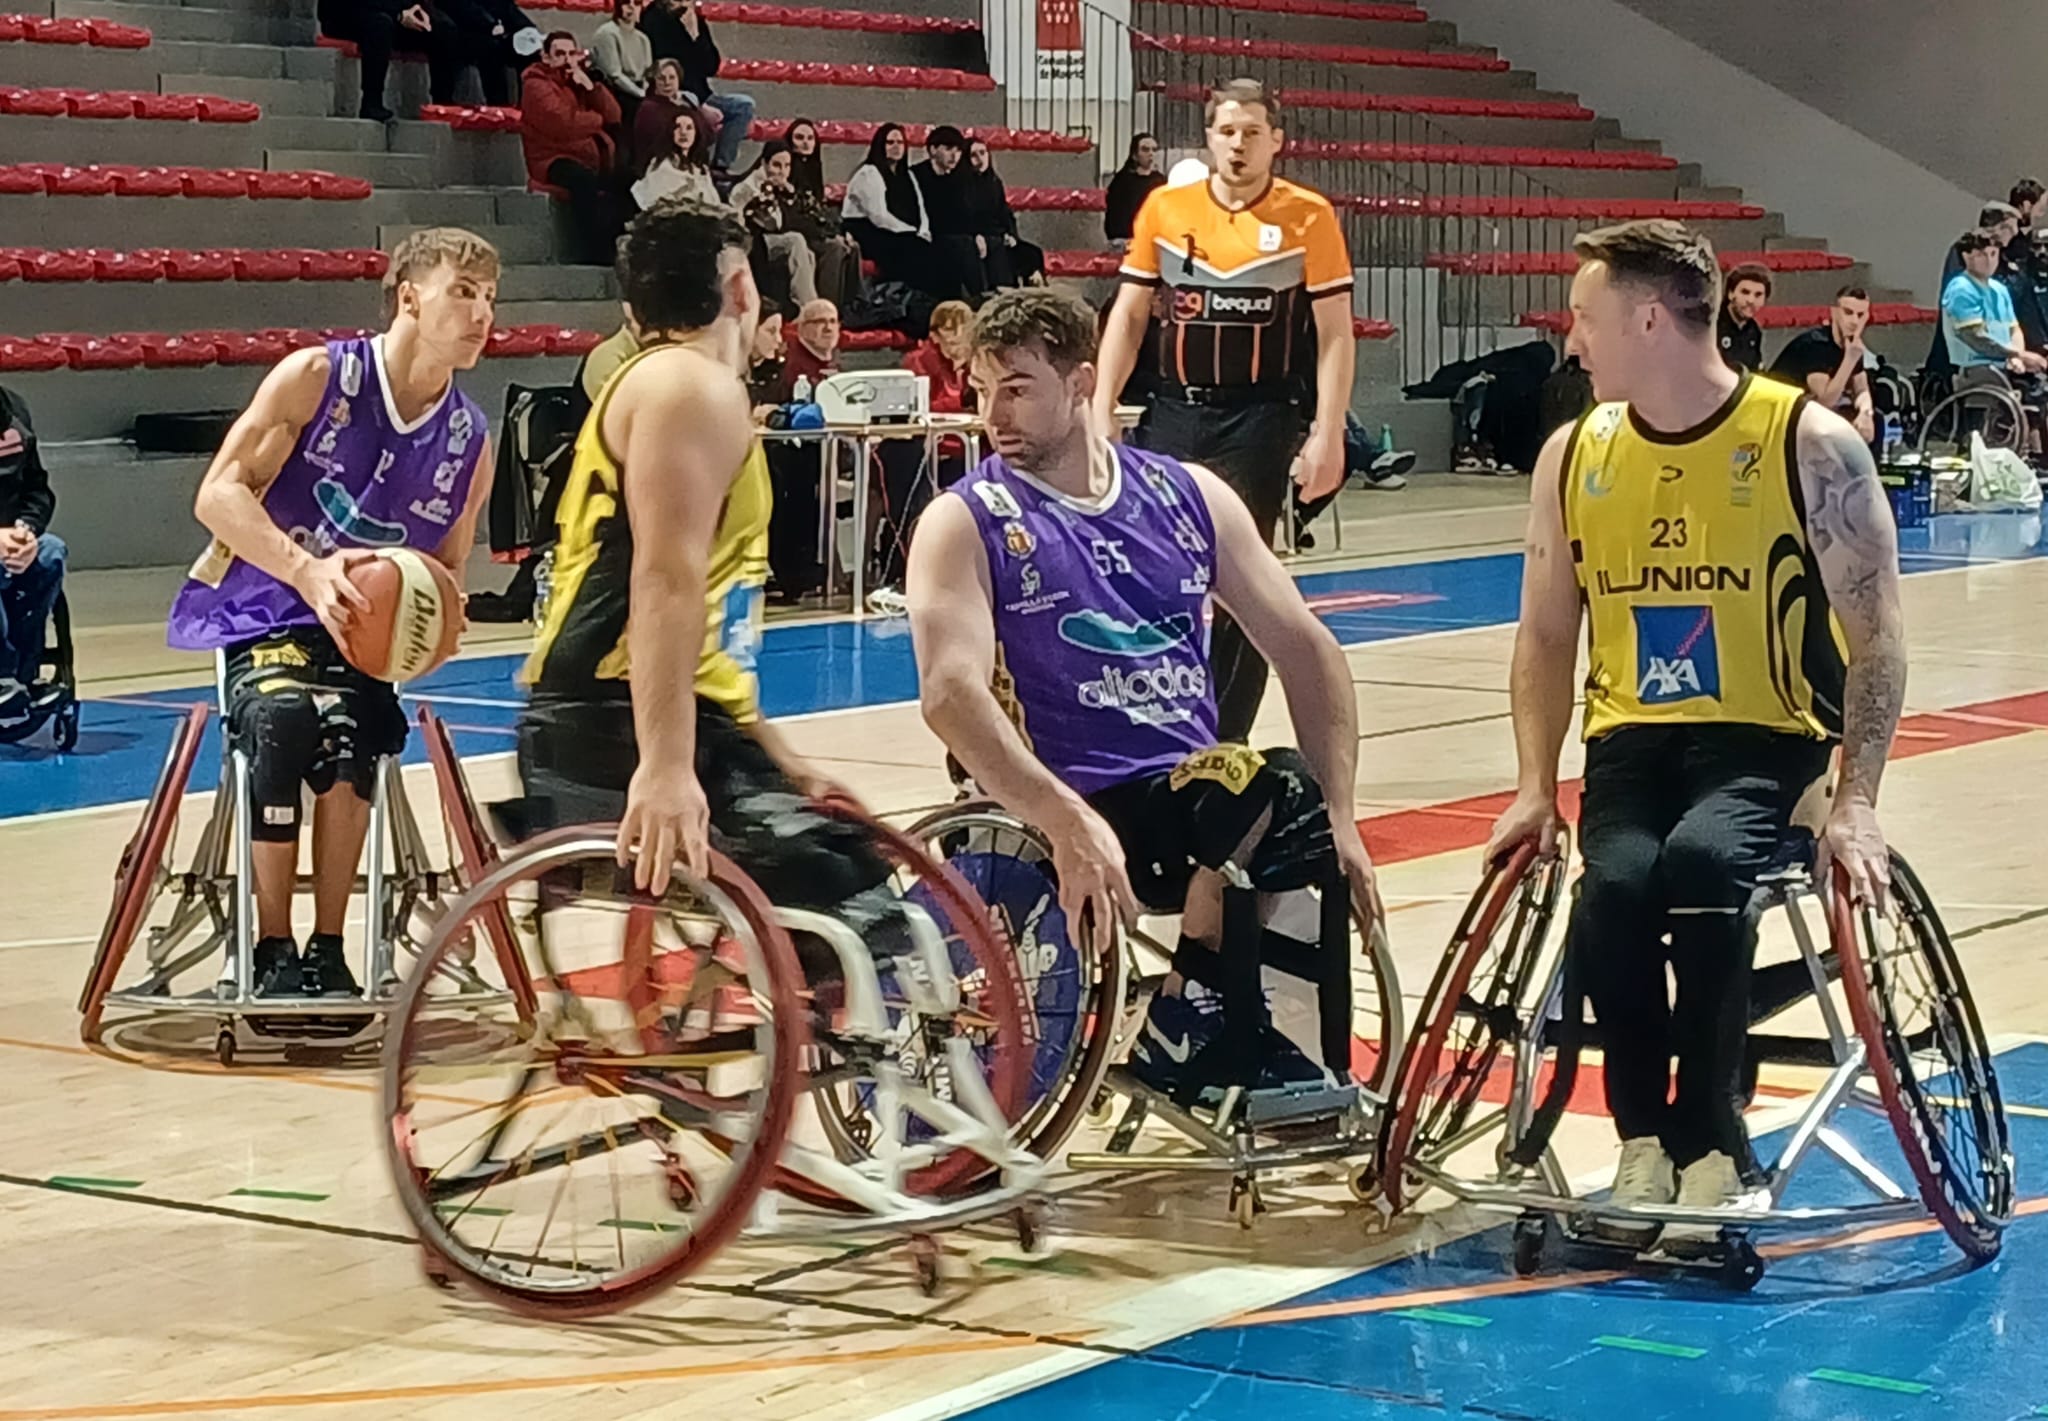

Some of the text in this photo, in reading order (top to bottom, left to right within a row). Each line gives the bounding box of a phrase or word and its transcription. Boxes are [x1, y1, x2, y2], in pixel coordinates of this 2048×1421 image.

[1650, 518, 1688, 548] 23
[1091, 539, 1133, 577] 55
[1639, 656, 1701, 698] AXA
